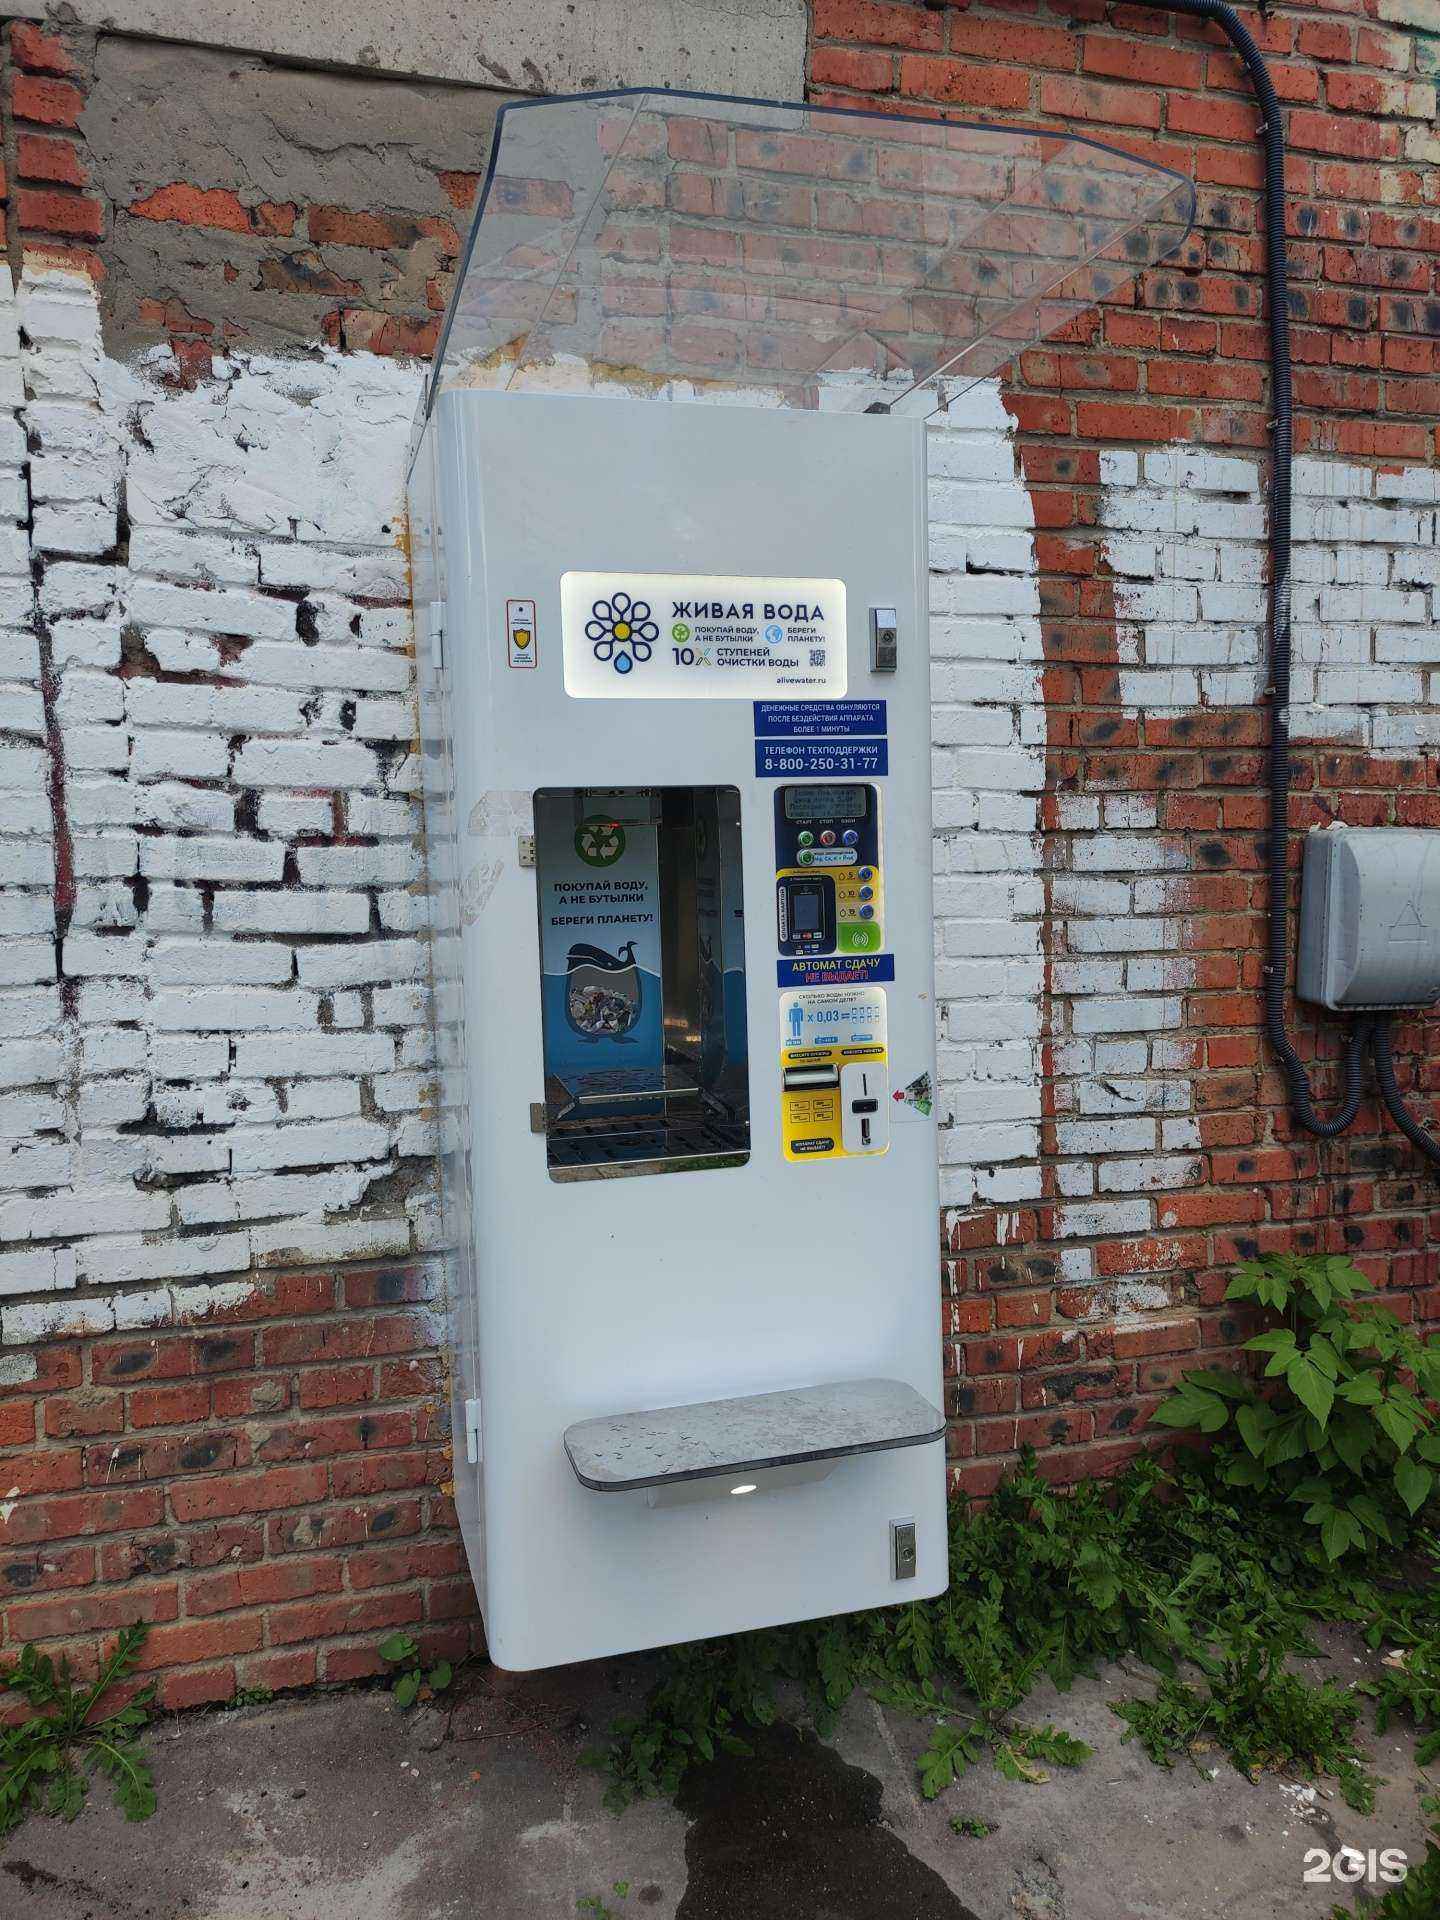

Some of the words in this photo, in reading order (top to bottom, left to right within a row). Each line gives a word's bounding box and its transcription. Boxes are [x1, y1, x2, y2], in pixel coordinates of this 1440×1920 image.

[672, 601, 754, 619] ЖИВАЯ
[764, 603, 825, 623] ВОДА
[694, 626, 735, 634] ПОКУПАЙ
[736, 627, 760, 636] ВОДУ,
[694, 635, 702, 643] А
[717, 648, 770, 657] СТУПЕНЕЙ
[717, 658, 766, 667] ОЧИСТКИ
[768, 659, 799, 668] ВОДЫ
[761, 704, 800, 712] ДЕНЕЖНЫЕ
[836, 703, 880, 711] ОБНУЛЯЮТСЯ
[791, 714, 838, 722] БЕЗДЕЙСТВИЯ
[764, 746, 805, 755] ТЕЛЕФОН
[807, 746, 878, 756] ТЕХПОДДЕРЖКИ
[764, 757, 879, 770] 8-800-250-31-77
[554, 880, 611, 892] ПОКУПАЙ
[614, 881, 649, 891] ВОДУ,
[558, 896, 568, 904] А
[571, 895, 586, 904] НЕ
[589, 894, 644, 904] БУТЫЛКИ
[551, 916, 594, 926] БЕРЕГИ
[597, 914, 653, 924] ПЛАНЕТУ!
[792, 960, 843, 972] АВТОМАТ
[845, 958, 880, 970] СДАЧУ
[805, 973, 820, 983] НЕ
[816, 1010, 839, 1023] 0,03
